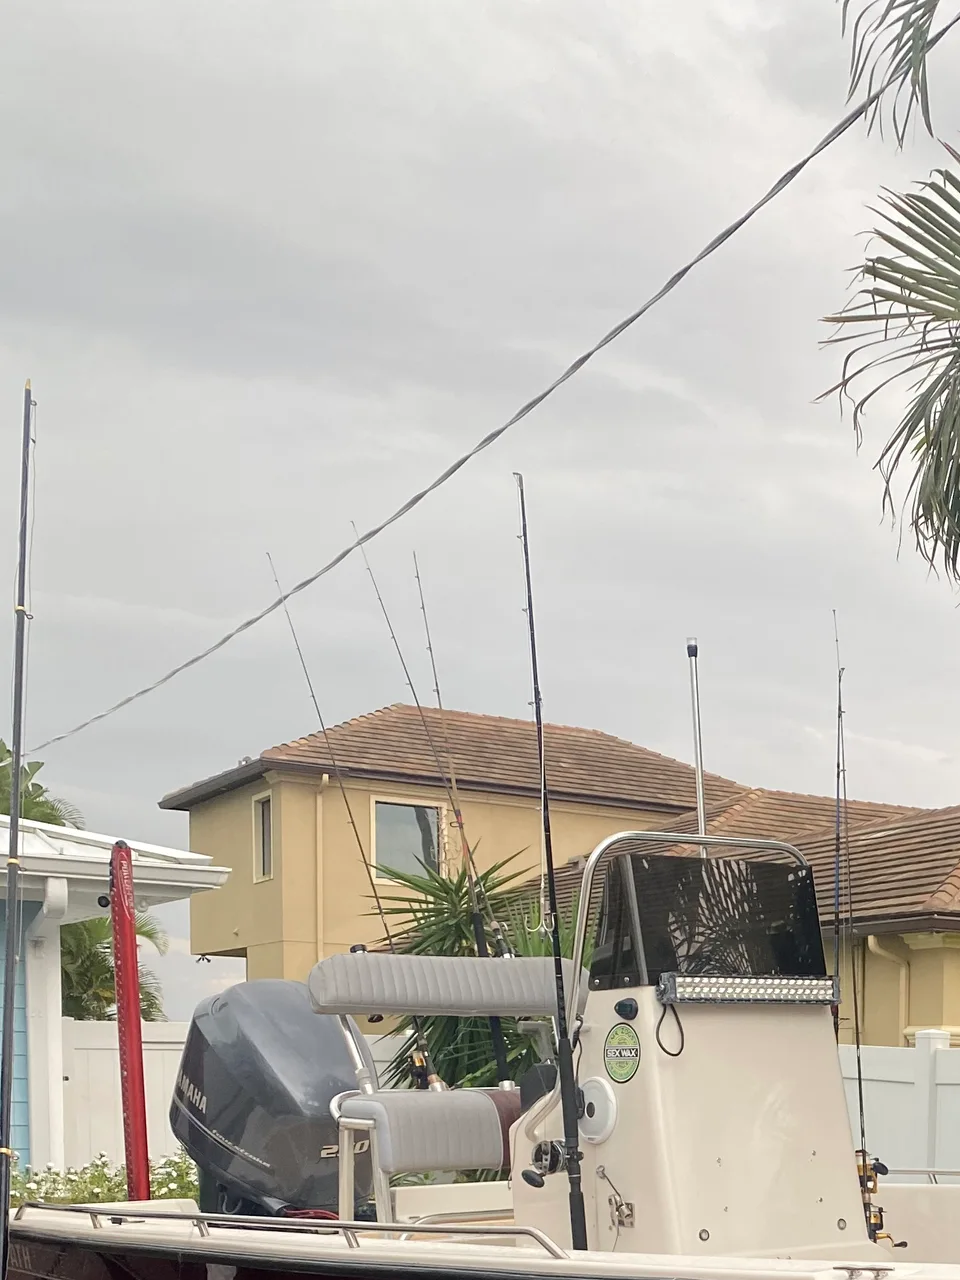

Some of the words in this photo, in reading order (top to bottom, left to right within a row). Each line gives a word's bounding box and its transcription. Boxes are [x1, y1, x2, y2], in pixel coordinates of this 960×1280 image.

[607, 1049, 620, 1058] SEX
[620, 1049, 636, 1057] WAX
[320, 1139, 370, 1158] 20
